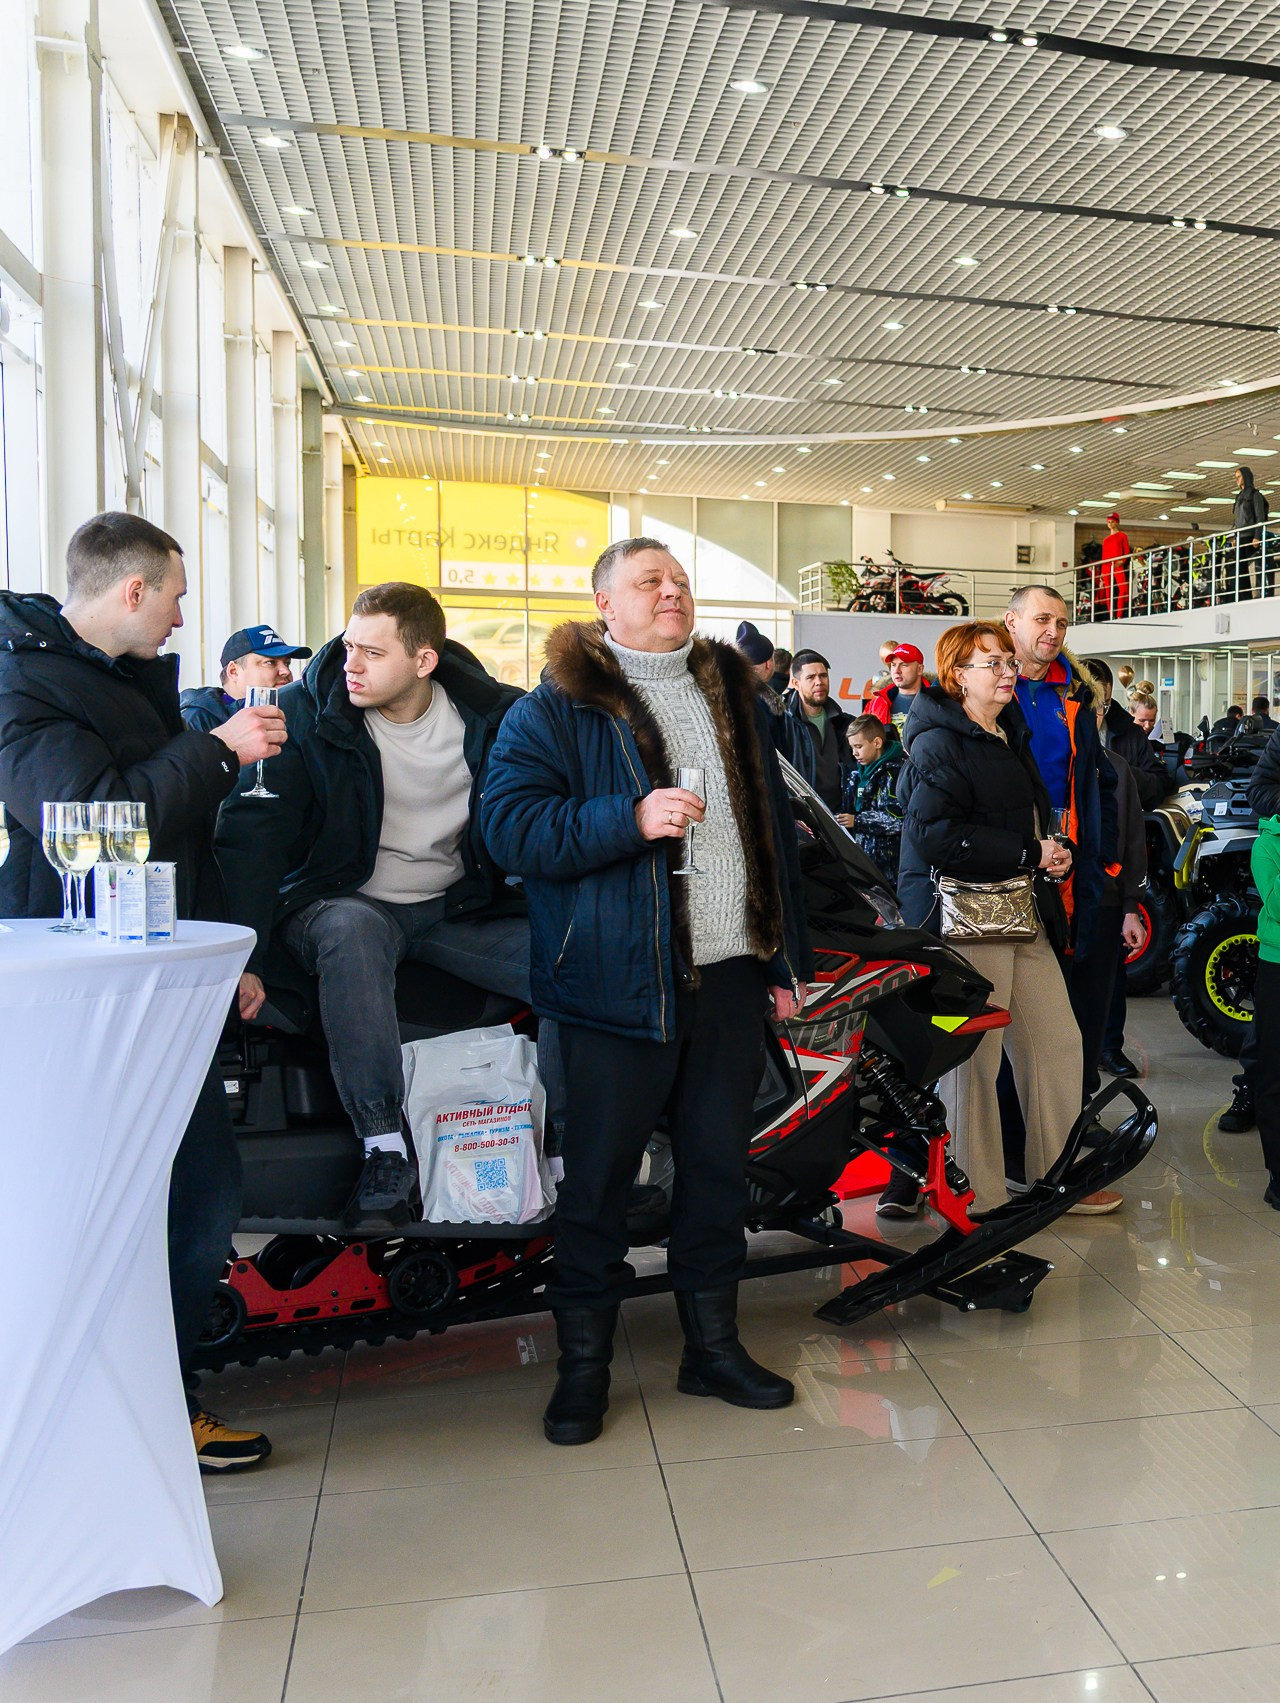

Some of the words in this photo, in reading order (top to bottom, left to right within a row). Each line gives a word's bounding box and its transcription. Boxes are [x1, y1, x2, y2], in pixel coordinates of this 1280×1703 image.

[435, 1105, 493, 1125] АКТИВНЫЙ
[496, 1102, 533, 1115] ОТДЫХ
[462, 1119, 477, 1128] СЕТЬ
[477, 1115, 512, 1126] МАГАЗИНОВ
[454, 1136, 520, 1153] 8-800-500-30-31
